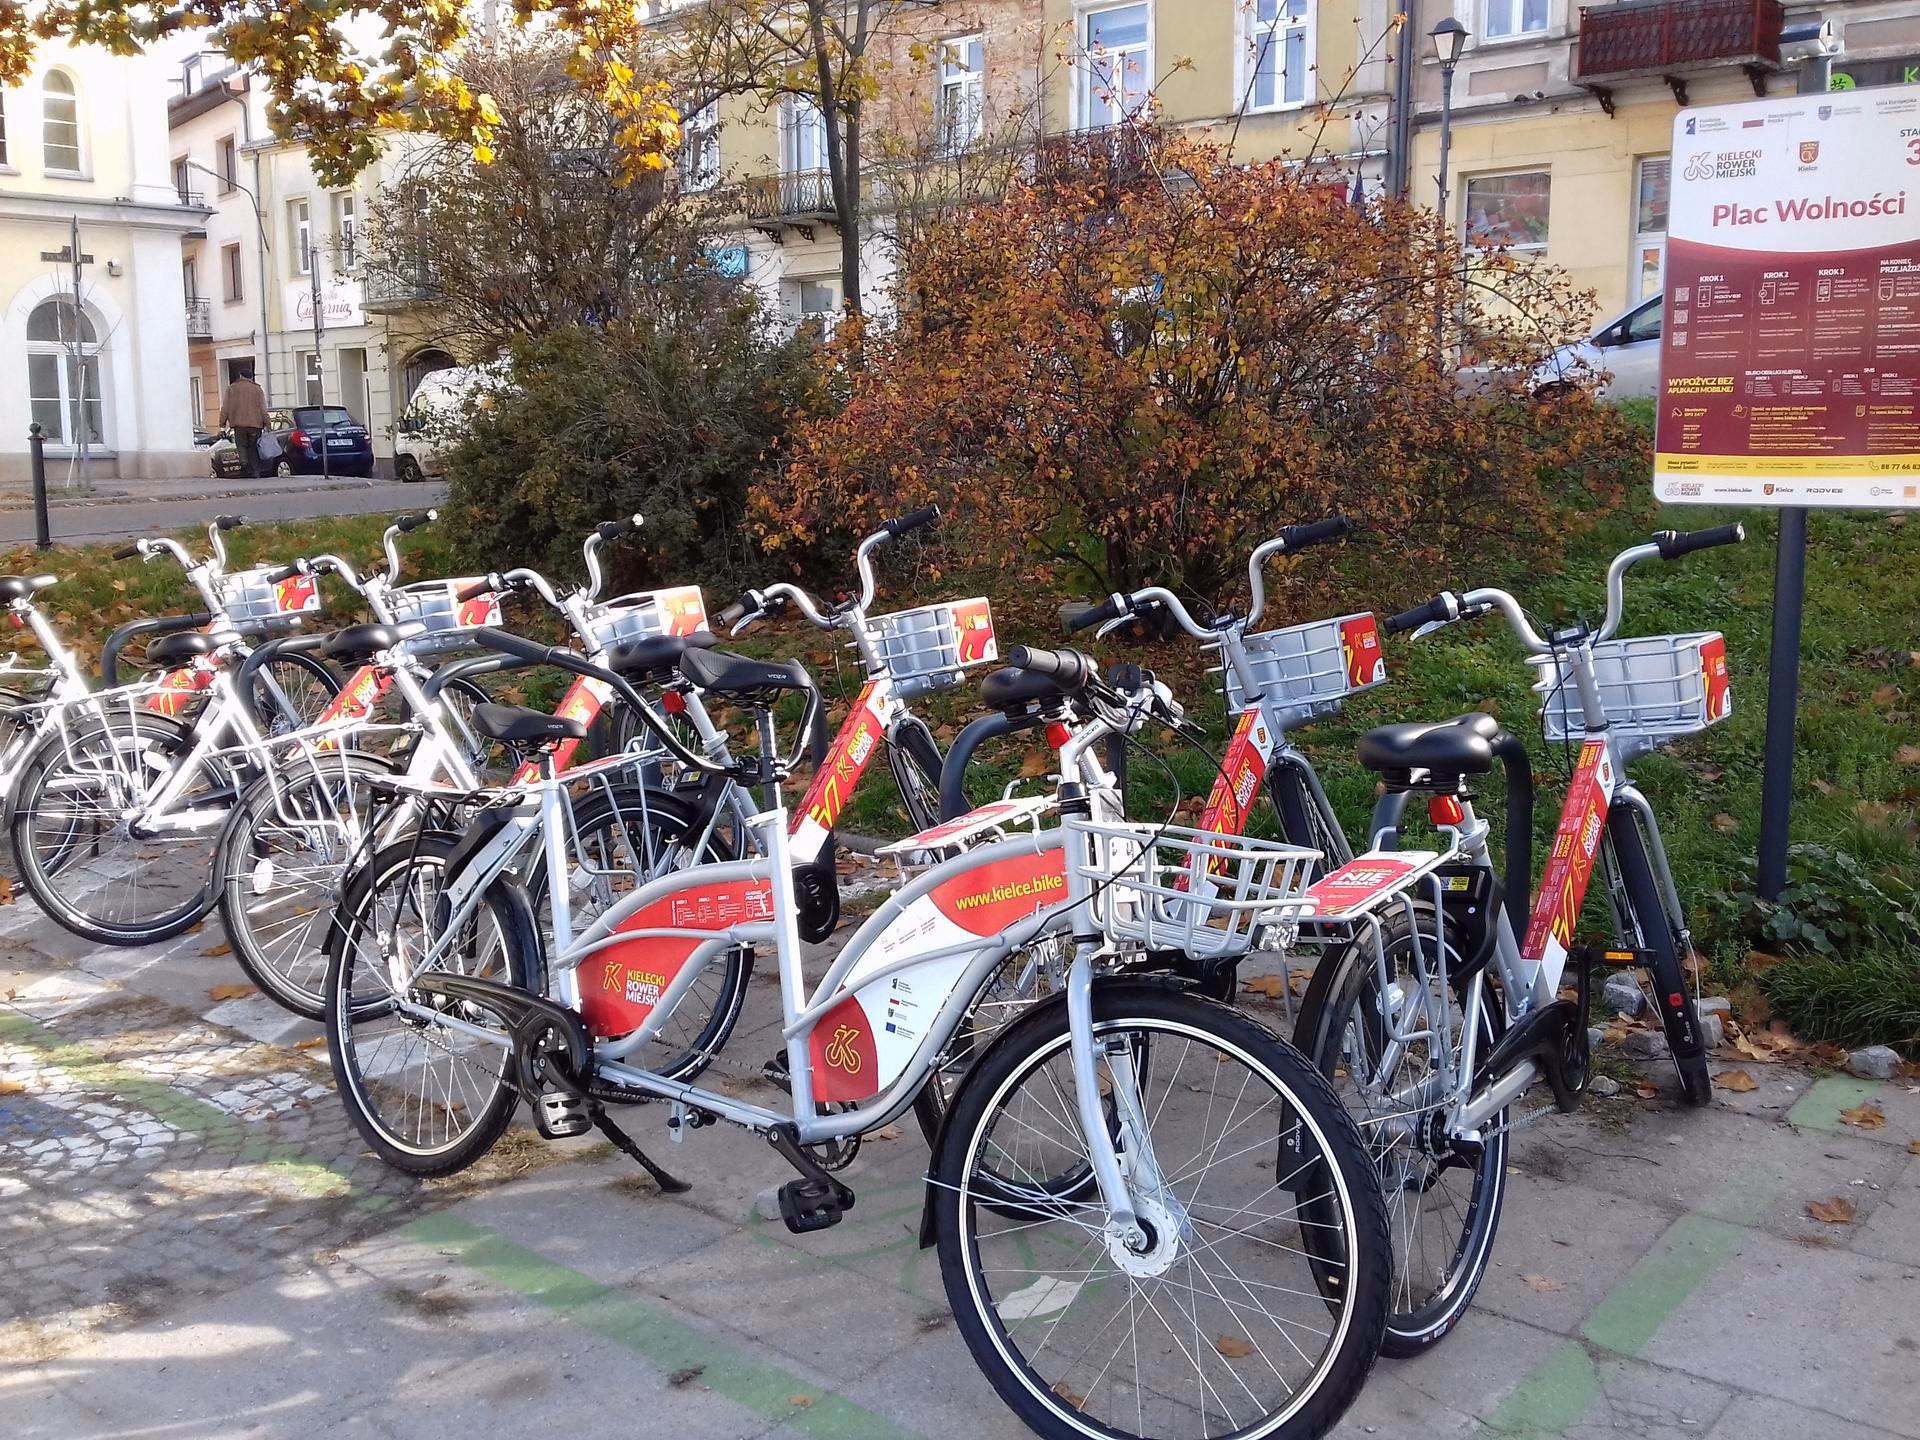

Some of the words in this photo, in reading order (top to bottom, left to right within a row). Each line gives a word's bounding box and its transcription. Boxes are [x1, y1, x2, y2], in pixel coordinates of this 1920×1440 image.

[1900, 128, 1920, 137] STA
[1717, 149, 1762, 161] KIELECKI
[1717, 159, 1755, 170] ROWER
[1716, 168, 1756, 179] MIEJSKI
[1713, 203, 1768, 227] Plac
[1775, 191, 1906, 222] Wolności
[297, 293, 352, 320] Cuernia
[1668, 376, 1717, 386] WYPOŻYCZ
[1718, 377, 1734, 385] BEZ
[1668, 386, 1700, 394] APLIKACJI
[1235, 768, 1253, 803] ROWER
[1240, 774, 1257, 809] MIEJSKI
[1336, 872, 1392, 883] NIE
[955, 874, 1063, 911] www.kielce.bike
[627, 969, 665, 987] KIELECKI
[626, 980, 659, 996] ROWER
[625, 990, 660, 1006] MIEJSKI
